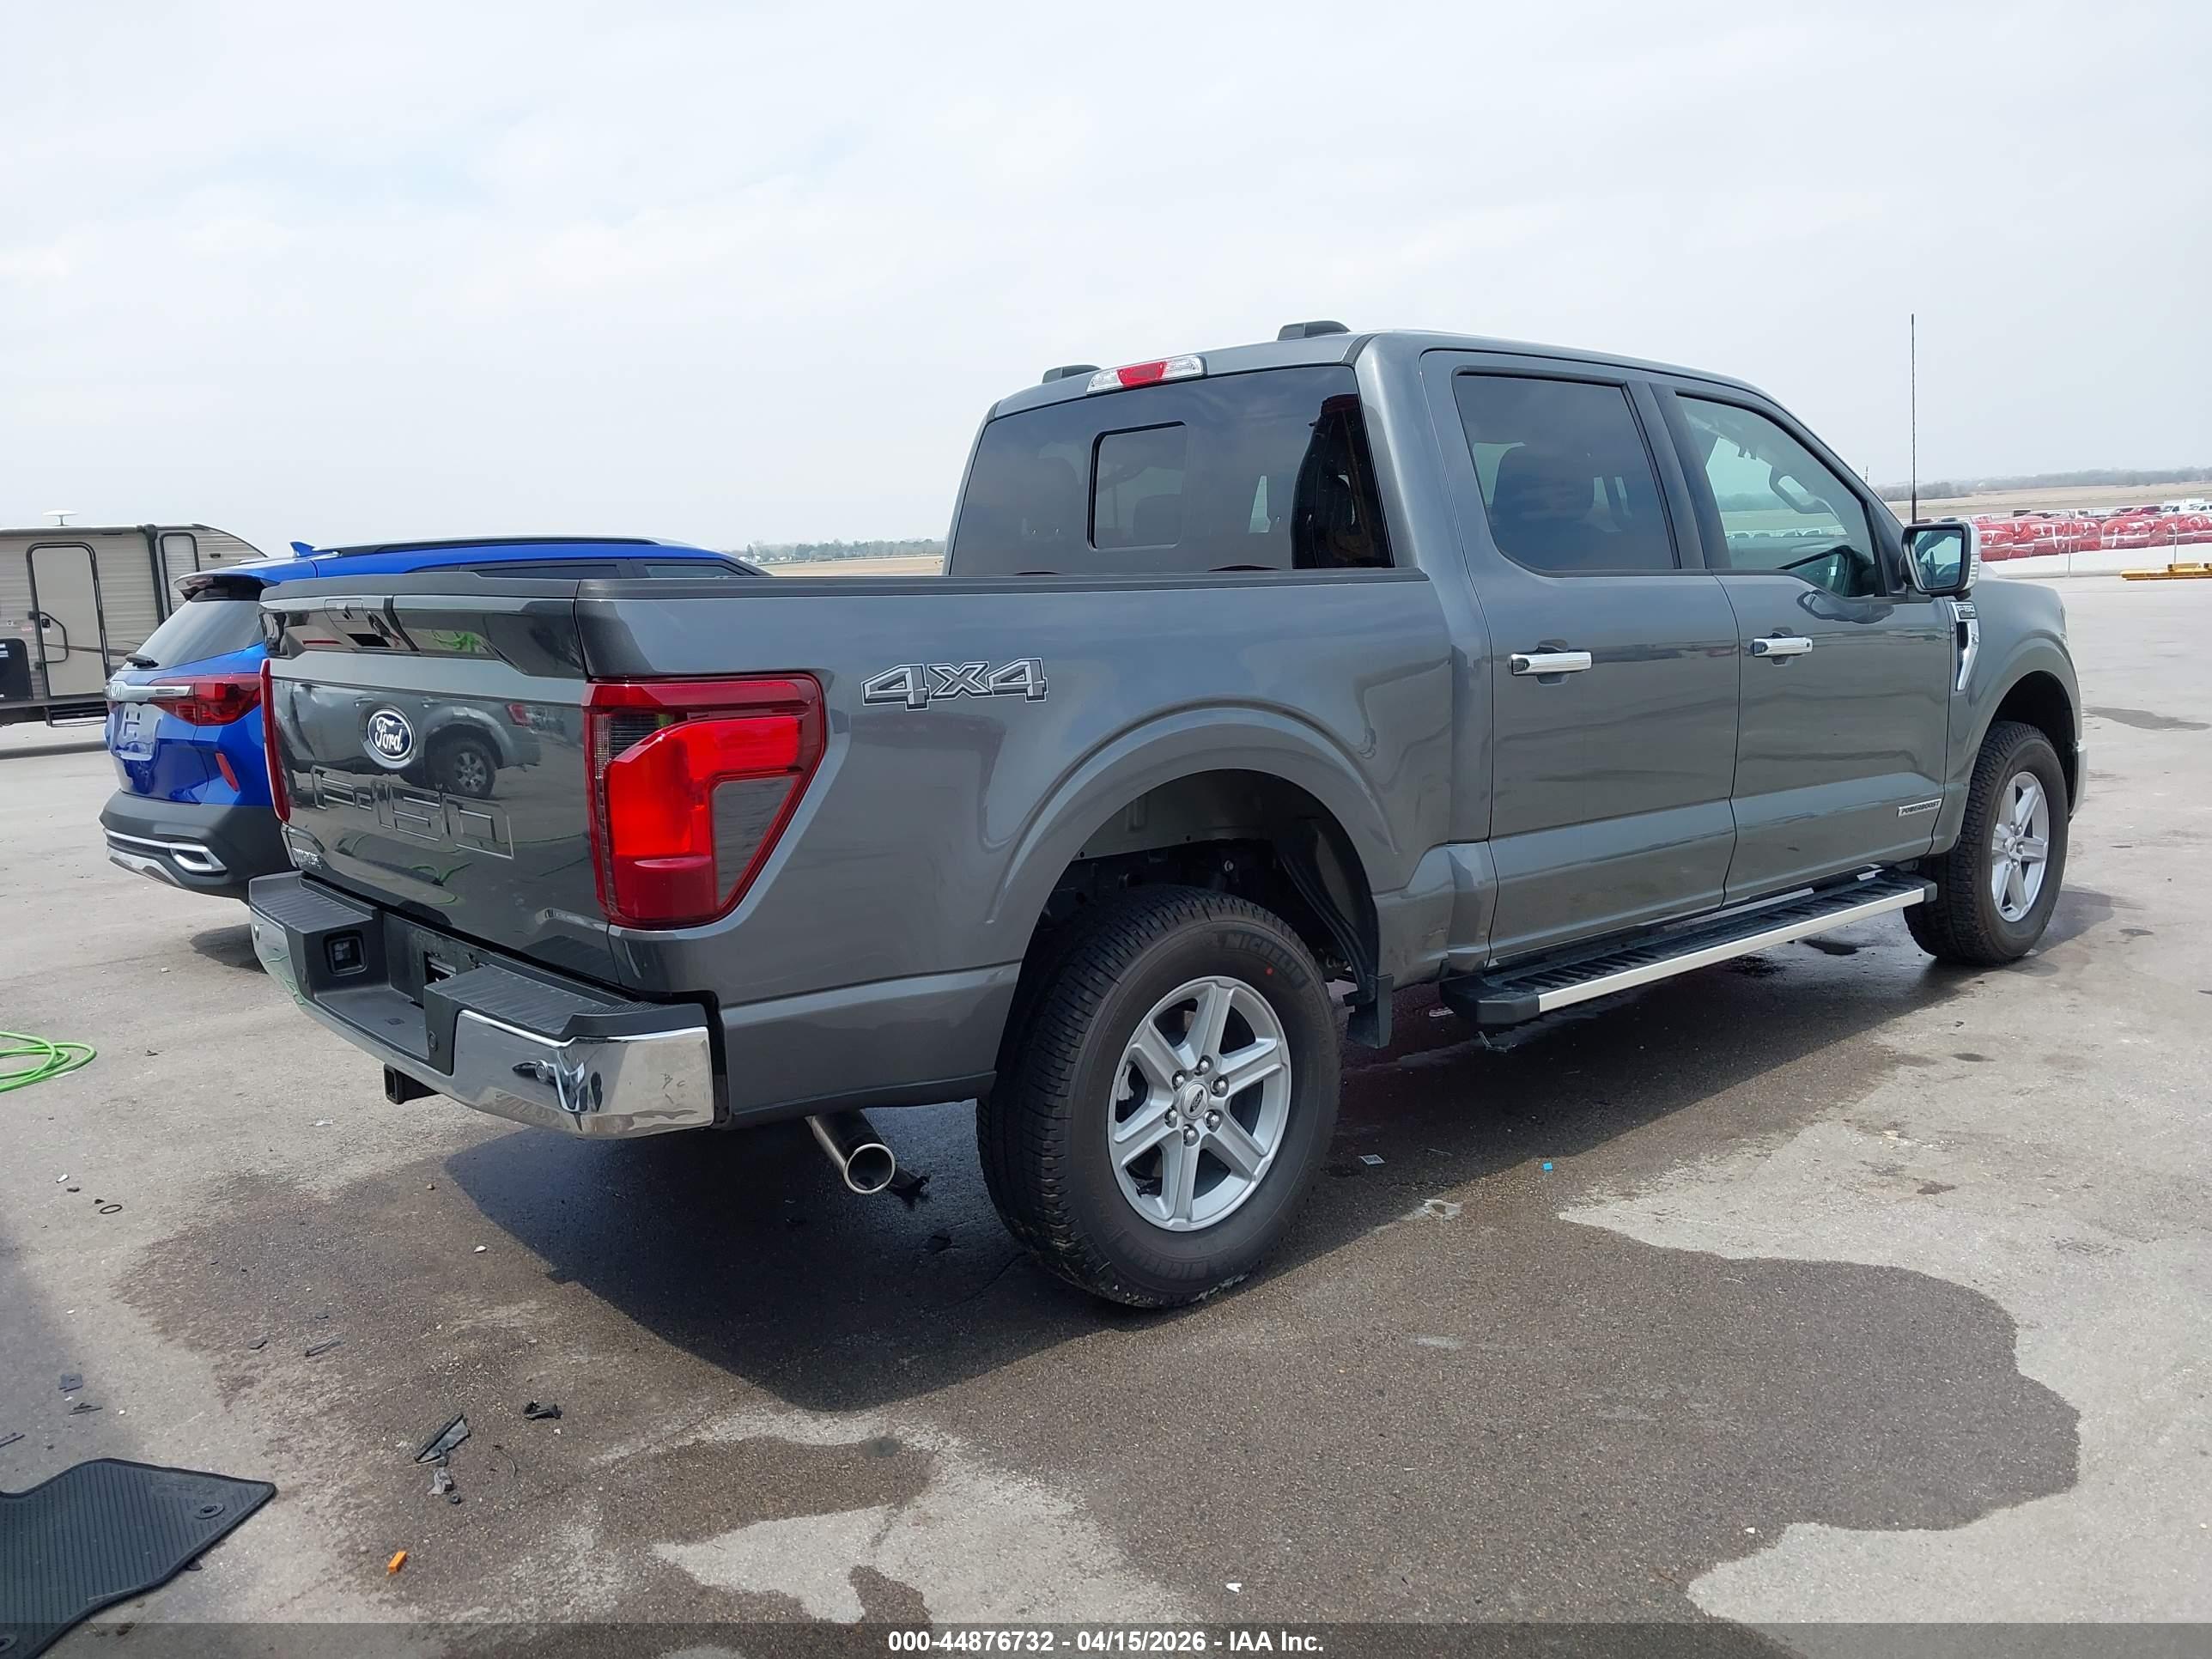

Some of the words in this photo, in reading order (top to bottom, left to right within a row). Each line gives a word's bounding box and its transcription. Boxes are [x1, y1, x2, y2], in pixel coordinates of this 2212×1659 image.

[860, 657, 1049, 712] 4X4
[374, 715, 404, 752] Ford
[310, 764, 514, 860] F-150
